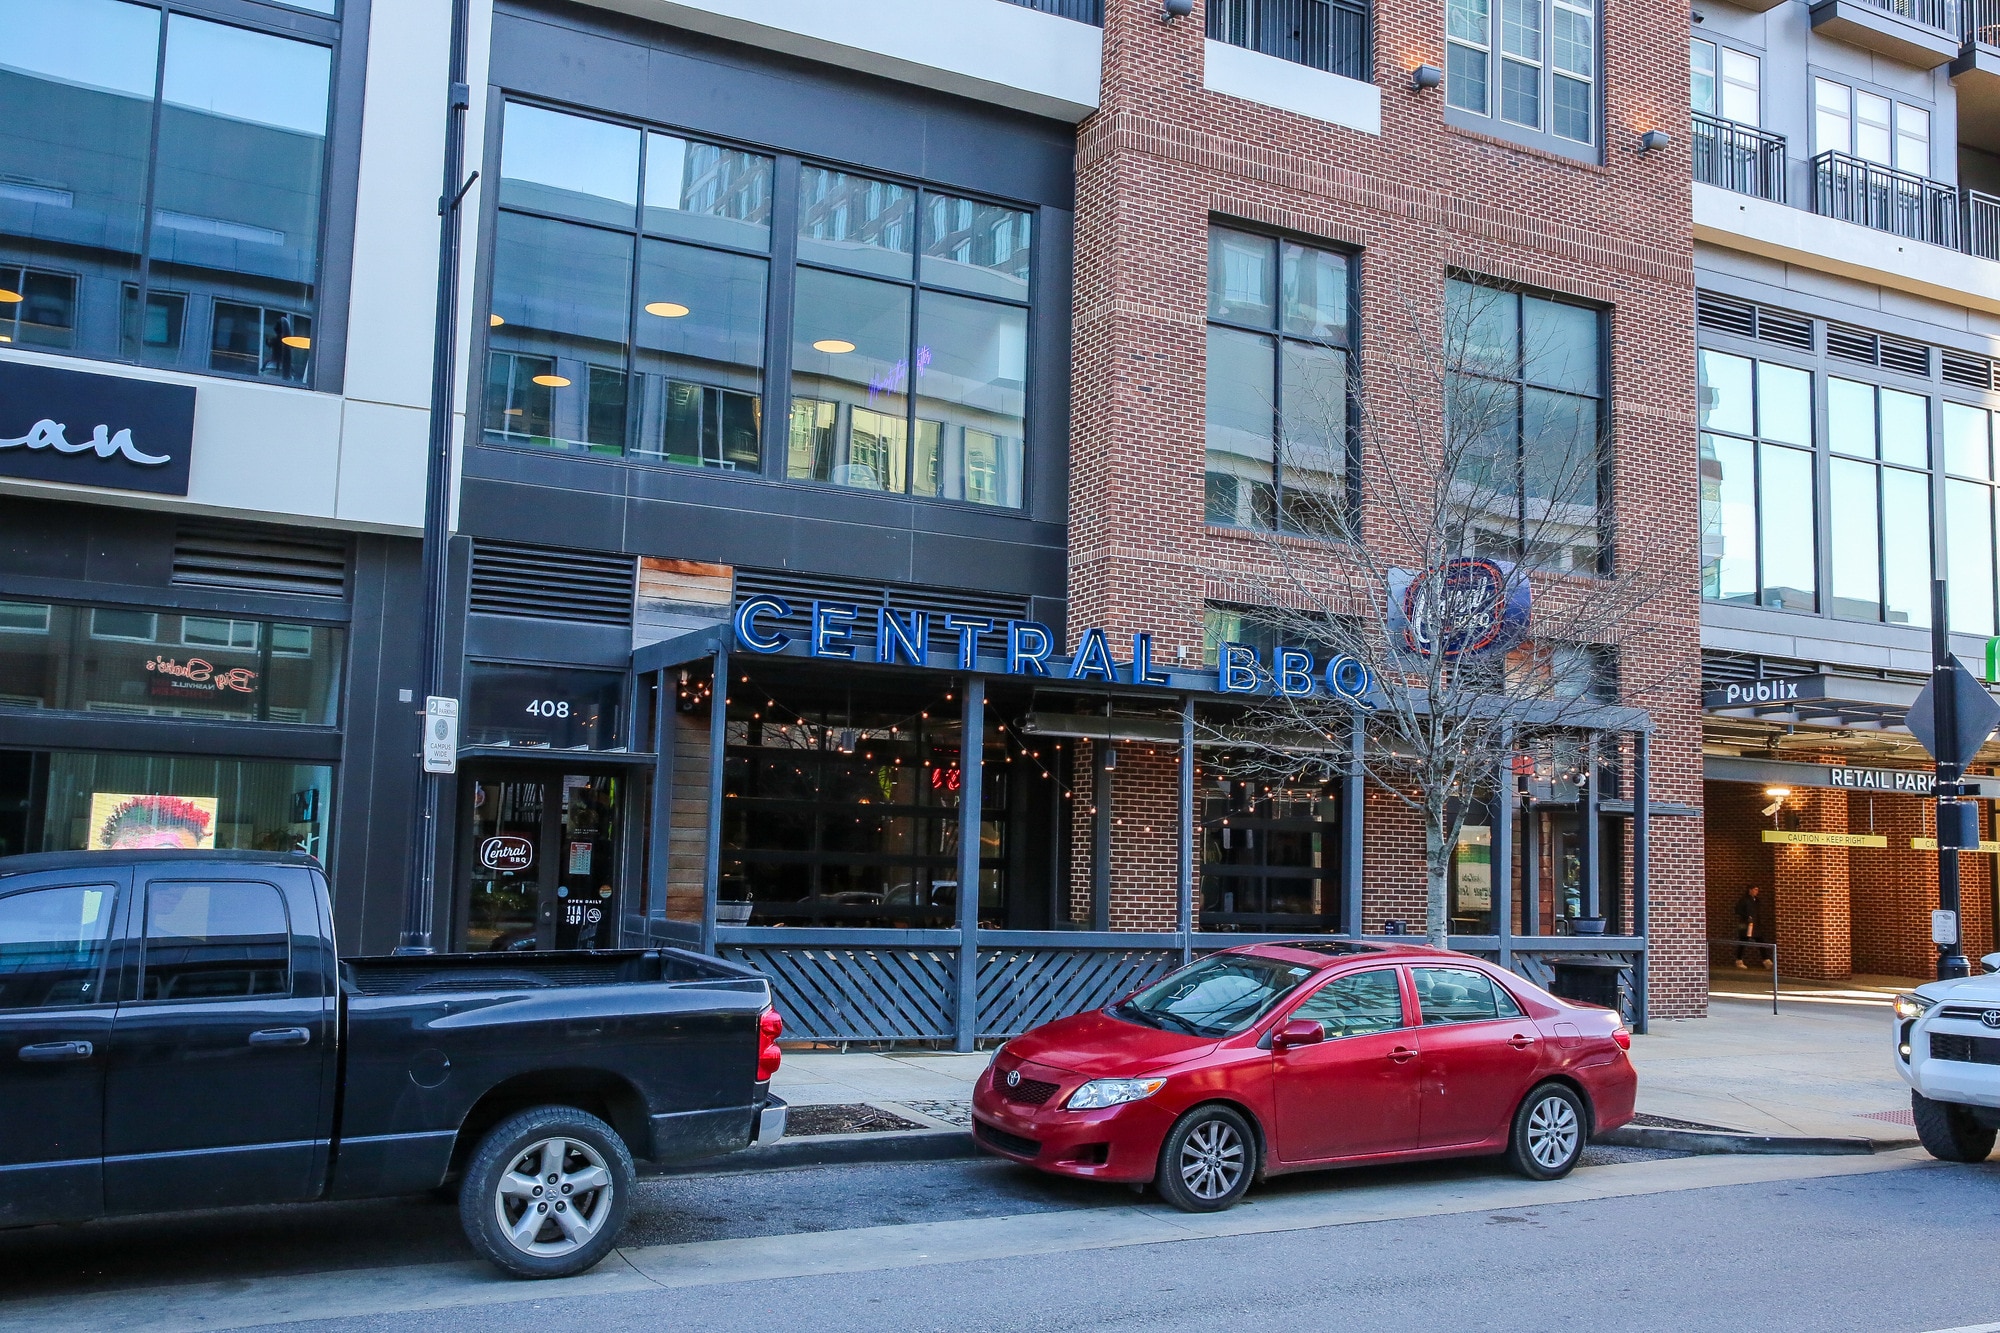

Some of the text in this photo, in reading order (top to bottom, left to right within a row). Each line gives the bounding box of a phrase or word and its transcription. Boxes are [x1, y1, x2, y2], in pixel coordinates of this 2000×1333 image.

[0, 418, 171, 464] an
[735, 594, 1378, 710] CENTRAL BBQ
[1727, 680, 1798, 703] Publix
[430, 701, 437, 713] 2
[525, 699, 569, 718] 408
[430, 742, 451, 751] CAMPUS
[1831, 768, 1890, 789] RETAIL
[1787, 833, 1819, 842] CAUTION
[1826, 836, 1843, 844] KEEP
[1845, 836, 1865, 845] RIGHT
[484, 839, 527, 865] Central
[510, 856, 527, 864] BBQ
[566, 905, 581, 915] 11A
[570, 915, 581, 925] 9P
